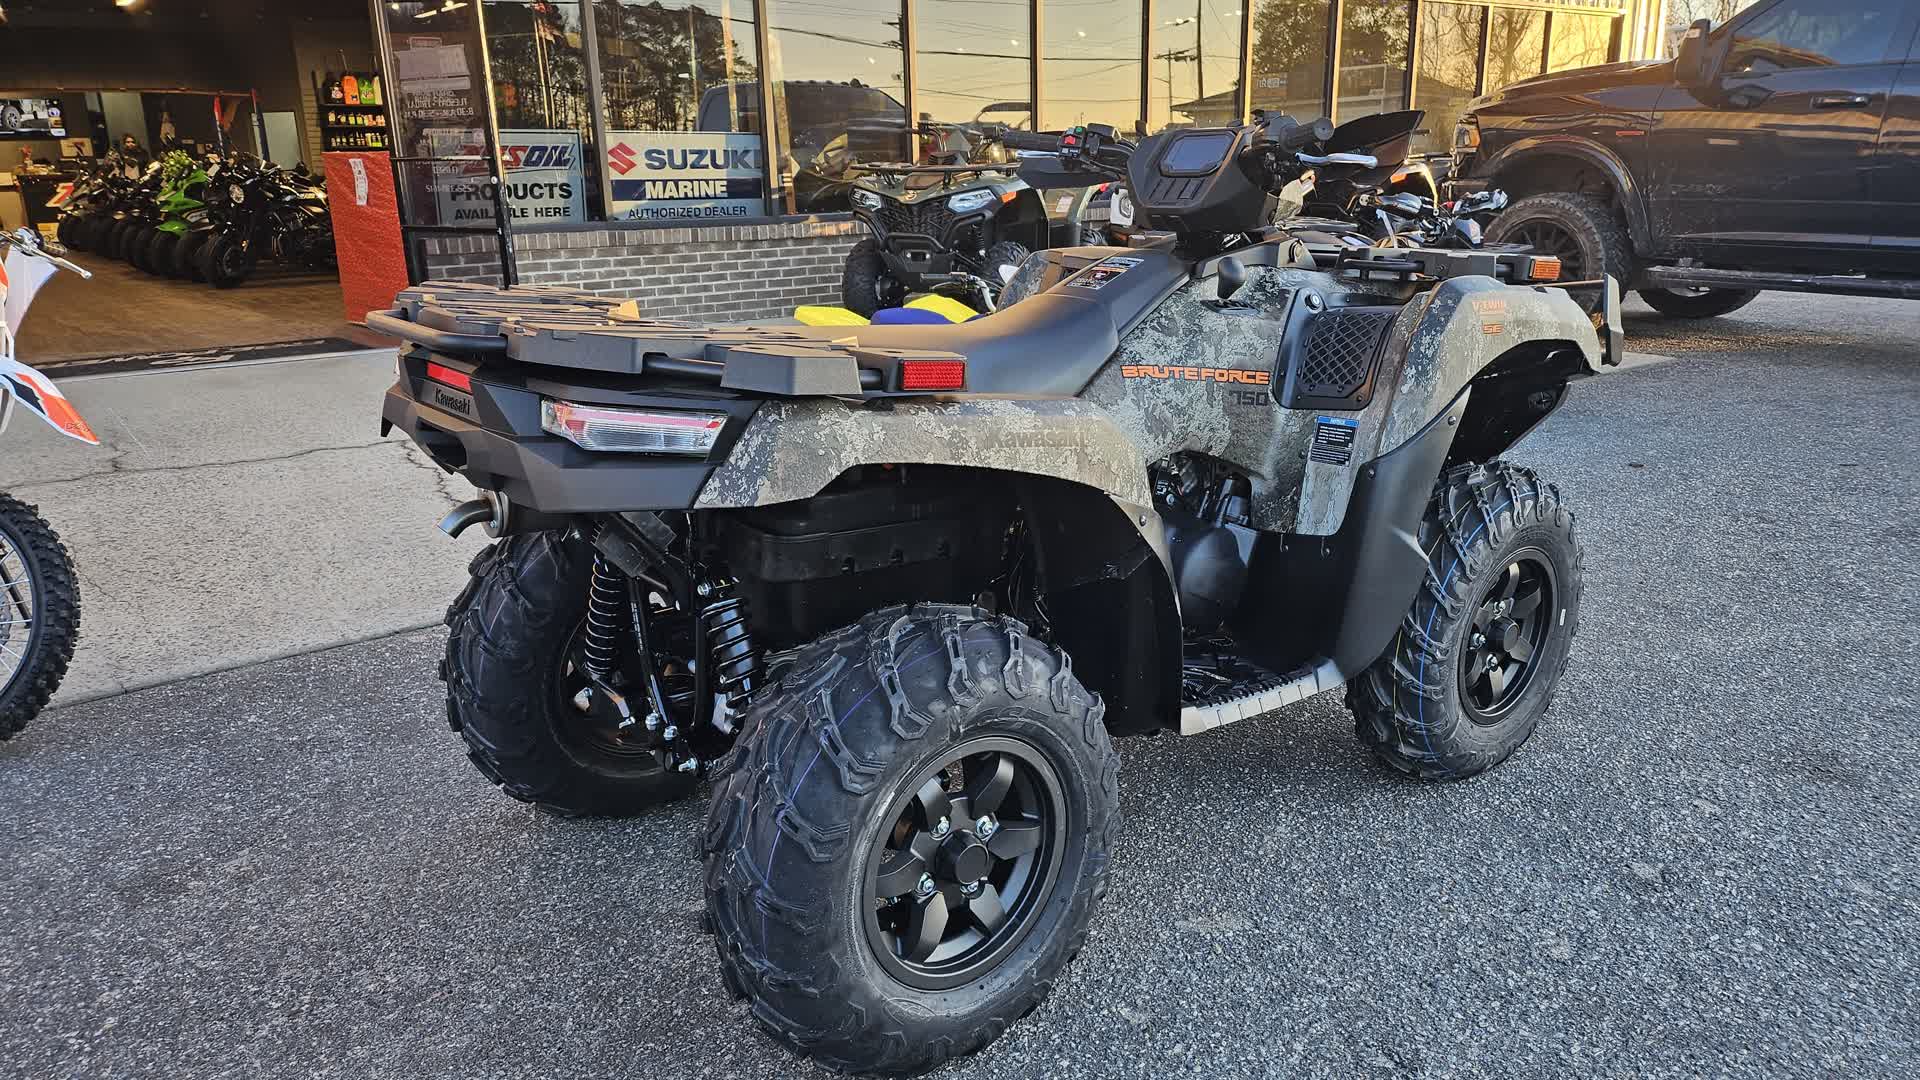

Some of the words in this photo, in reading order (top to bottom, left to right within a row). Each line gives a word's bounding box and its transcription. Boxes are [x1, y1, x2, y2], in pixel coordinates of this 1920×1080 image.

[645, 180, 728, 200] MARINE
[534, 206, 571, 218] HERE
[628, 206, 701, 219] AUTHORIZED
[704, 205, 748, 217] DEALER
[1120, 364, 1200, 381] BRUTE
[1200, 367, 1271, 385] FORCE
[435, 387, 471, 416] Kawasaki
[1228, 390, 1269, 407] 750
